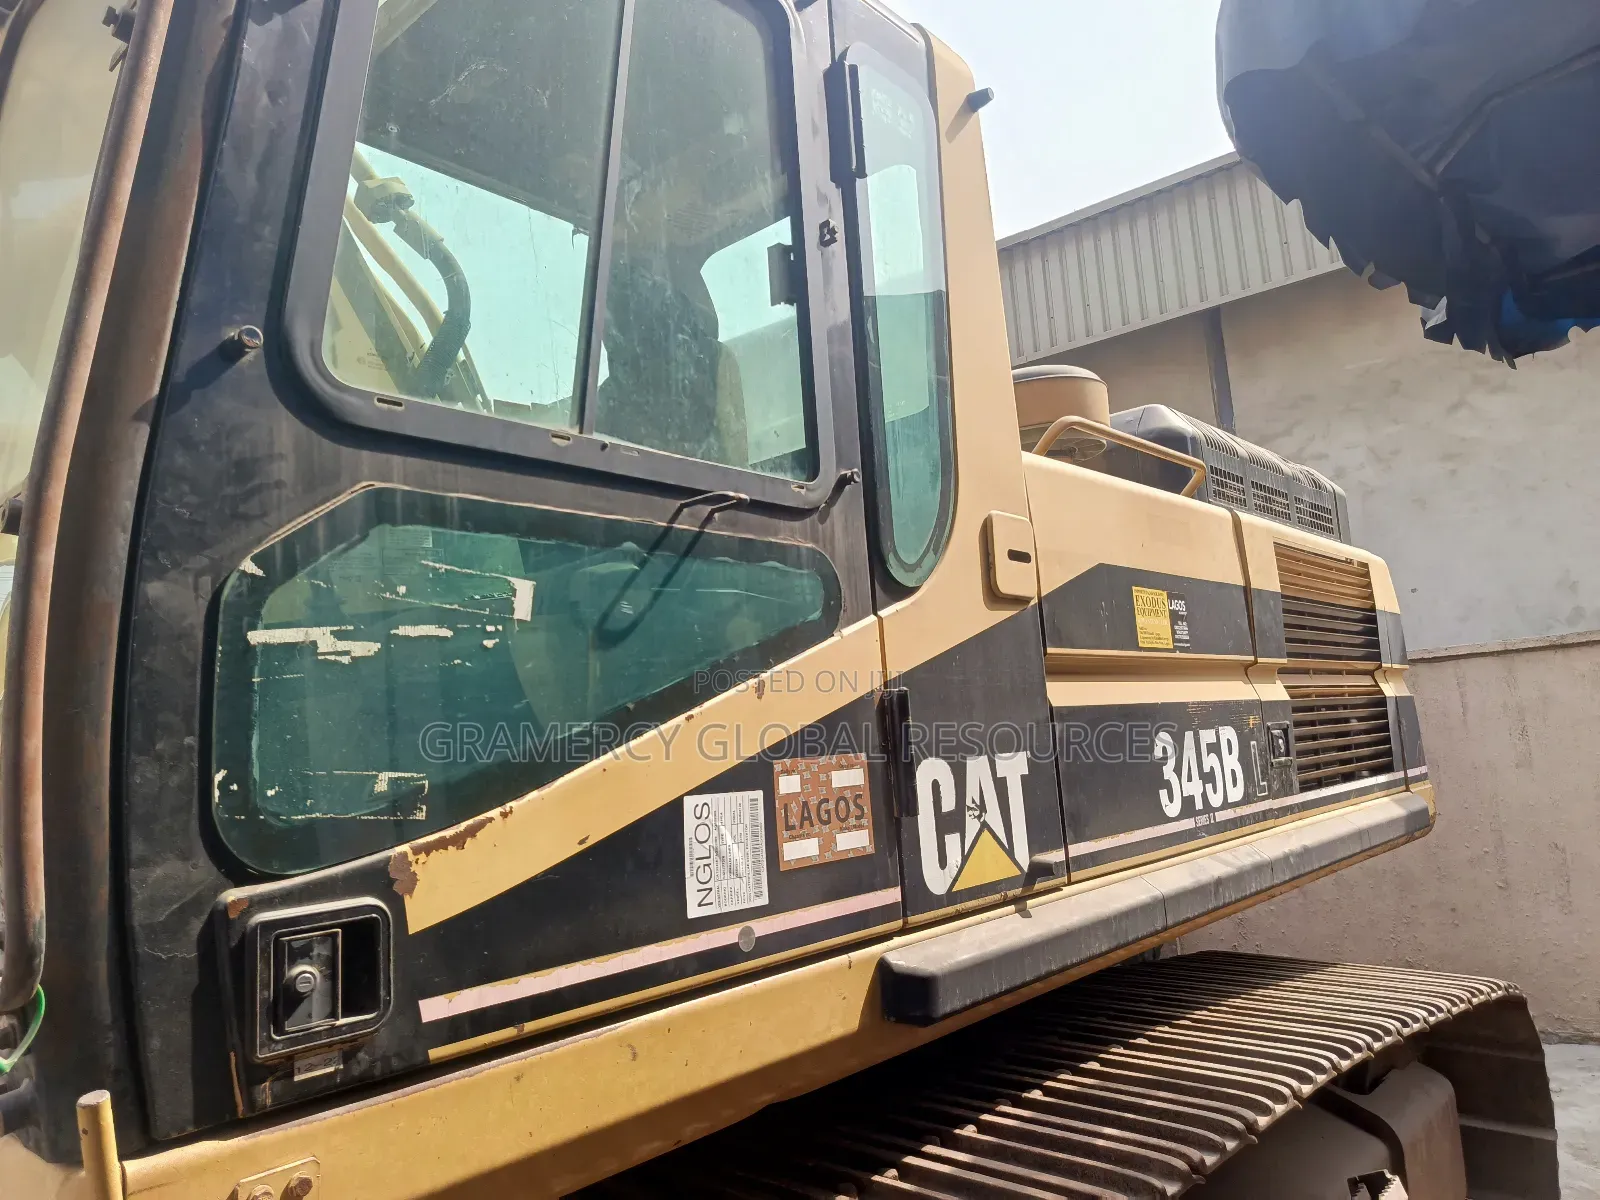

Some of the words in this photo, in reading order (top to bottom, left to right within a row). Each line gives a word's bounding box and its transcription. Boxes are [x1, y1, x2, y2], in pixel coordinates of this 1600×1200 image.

[1136, 595, 1167, 609] EXODUS
[1137, 607, 1167, 618] EQUIPMENT
[1168, 599, 1186, 611] LAGOS
[1153, 726, 1245, 818] 345B
[1250, 740, 1269, 797] L
[783, 793, 865, 831] LAGOS
[915, 751, 1030, 895] CAT
[694, 802, 713, 907] NGLOS
